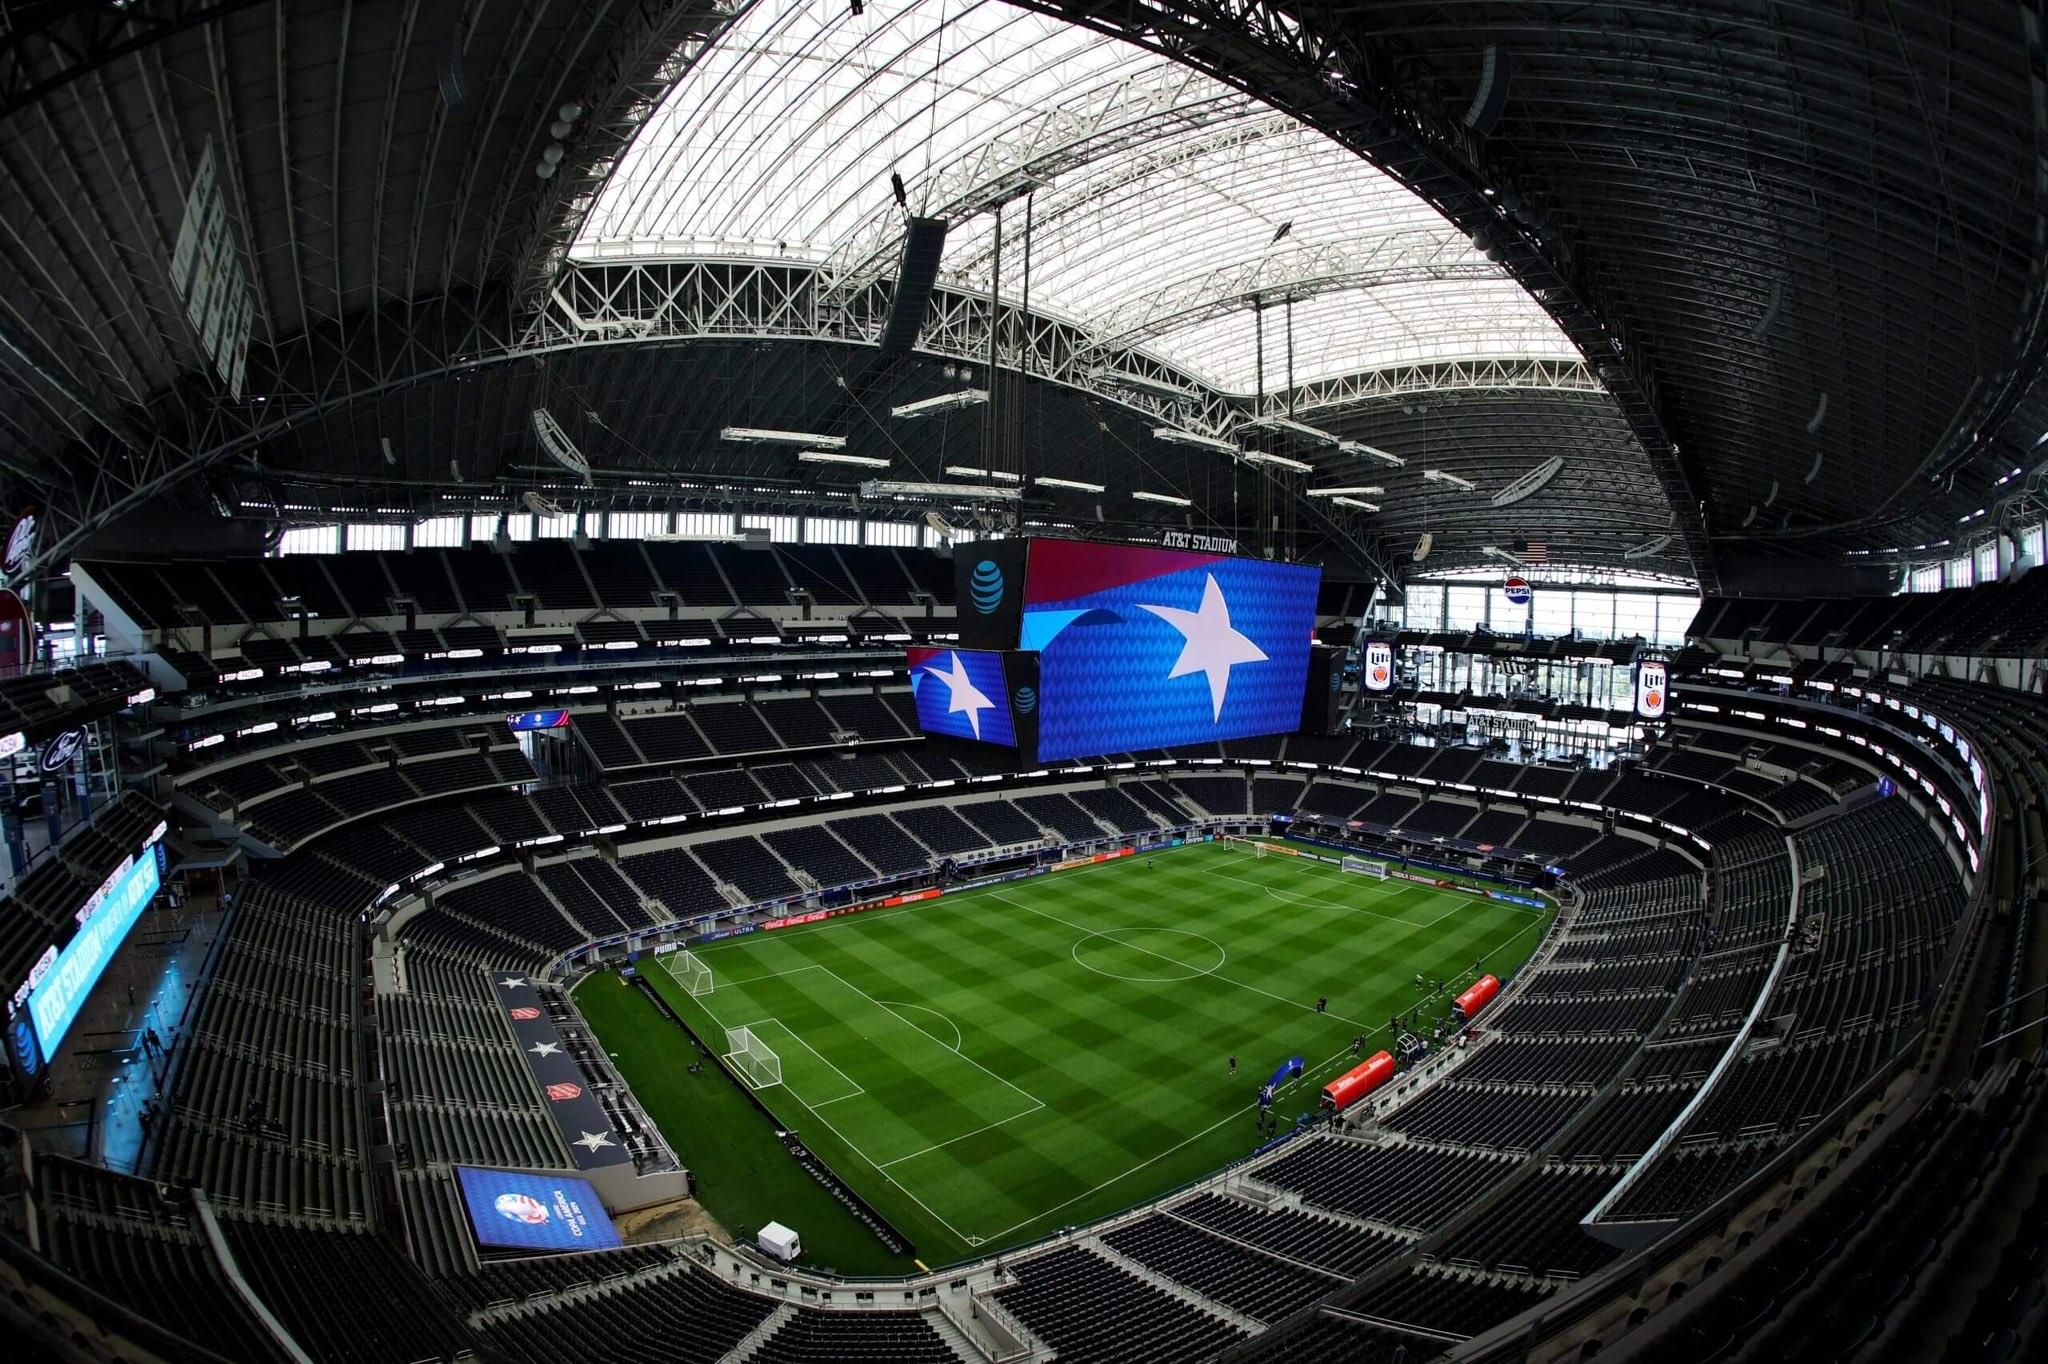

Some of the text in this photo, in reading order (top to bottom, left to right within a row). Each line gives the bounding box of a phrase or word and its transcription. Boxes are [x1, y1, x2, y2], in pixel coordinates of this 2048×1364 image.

[1162, 531, 1237, 554] AT&T STADIUM
[1505, 587, 1530, 595] PEPSI
[356, 657, 371, 665] STOP
[1371, 651, 1390, 666] Lite
[1500, 660, 1527, 676] Lite
[224, 673, 237, 681] STOP
[1644, 673, 1665, 689] Lite
[1468, 715, 1535, 732] AT&T STADIUM
[49, 731, 82, 765] Ford
[734, 926, 754, 935] ULTRA
[654, 942, 677, 954] PUMA
[38, 975, 66, 1040] AT&T
[61, 925, 103, 1002] STADIUM
